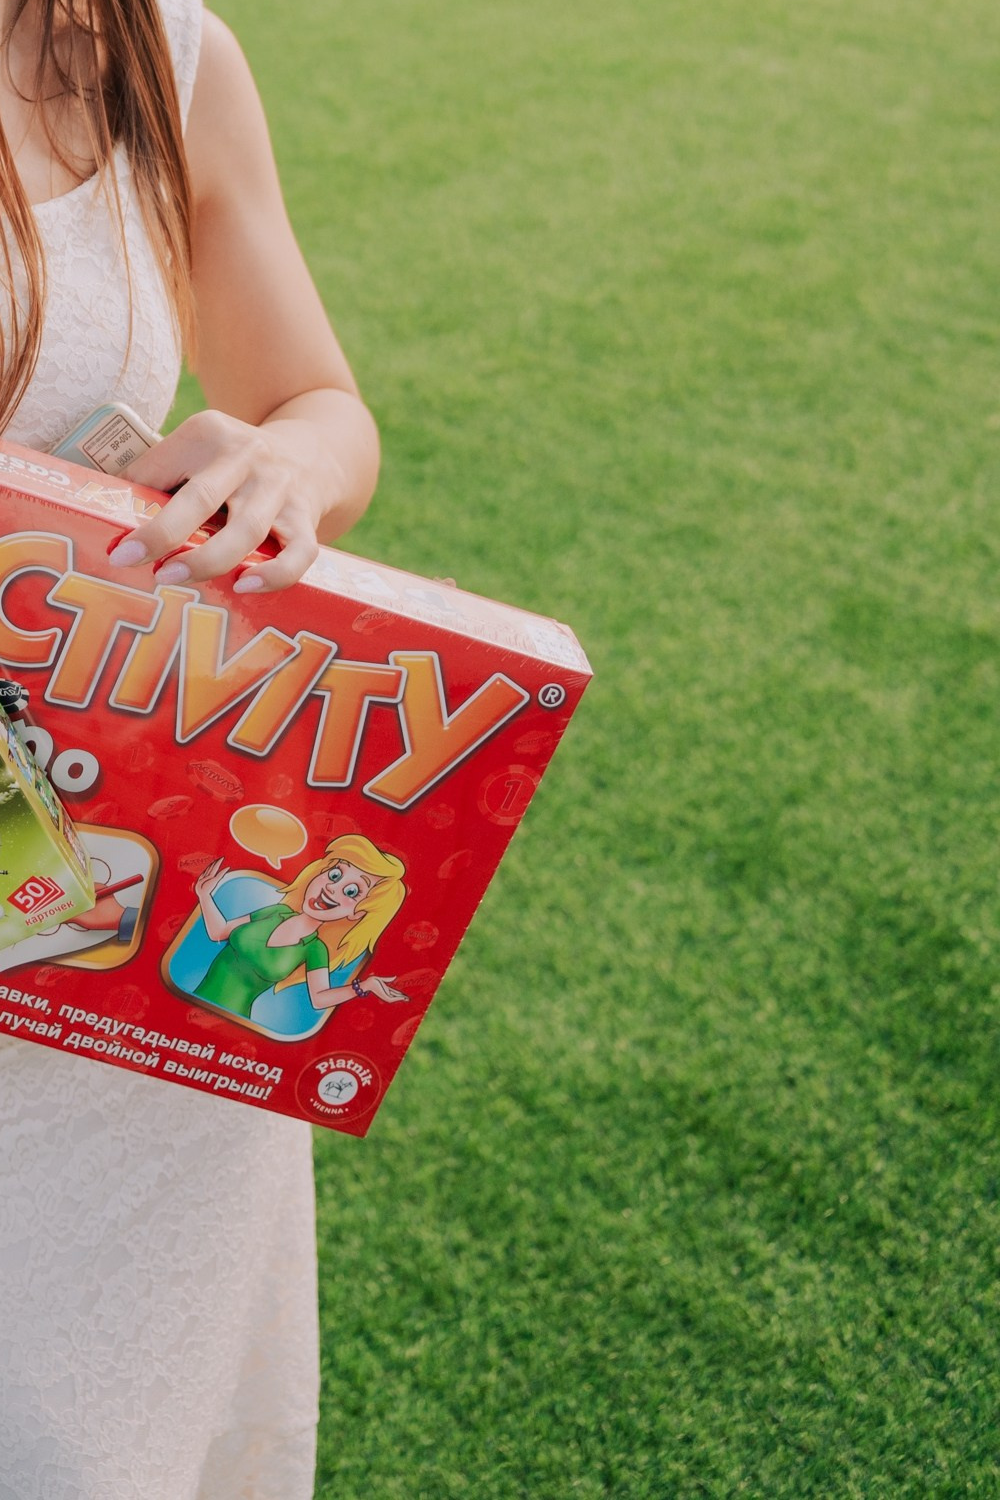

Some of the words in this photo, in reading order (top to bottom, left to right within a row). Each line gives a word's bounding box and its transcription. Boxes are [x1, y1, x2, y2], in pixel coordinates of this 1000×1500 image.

[14, 882, 45, 908] 50
[25, 900, 75, 926] карточек
[58, 1004, 216, 1060] предугадывай
[218, 1050, 284, 1084] исход
[63, 1031, 161, 1068] двойной
[163, 1058, 276, 1101] выигрыш!
[315, 1058, 373, 1087] Piatnik
[312, 1100, 344, 1114] VIENNA
